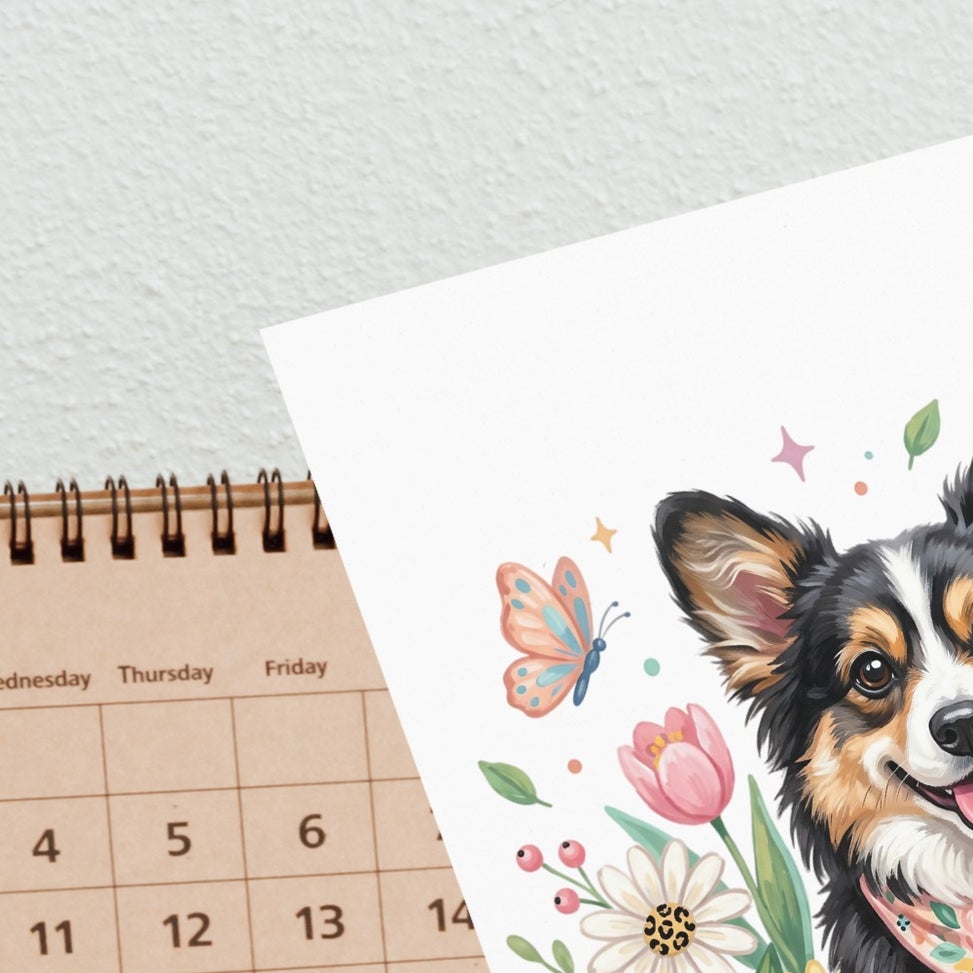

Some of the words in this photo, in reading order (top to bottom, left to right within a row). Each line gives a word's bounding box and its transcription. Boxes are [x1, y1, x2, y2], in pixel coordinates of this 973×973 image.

[117, 664, 214, 685] Thursday
[265, 657, 328, 679] Friday
[32, 828, 61, 863] 4
[166, 821, 192, 857] 5
[298, 813, 326, 849] 6
[29, 919, 74, 956] 11
[162, 911, 213, 949] 12
[295, 903, 346, 941] 13
[428, 897, 475, 932] 14
